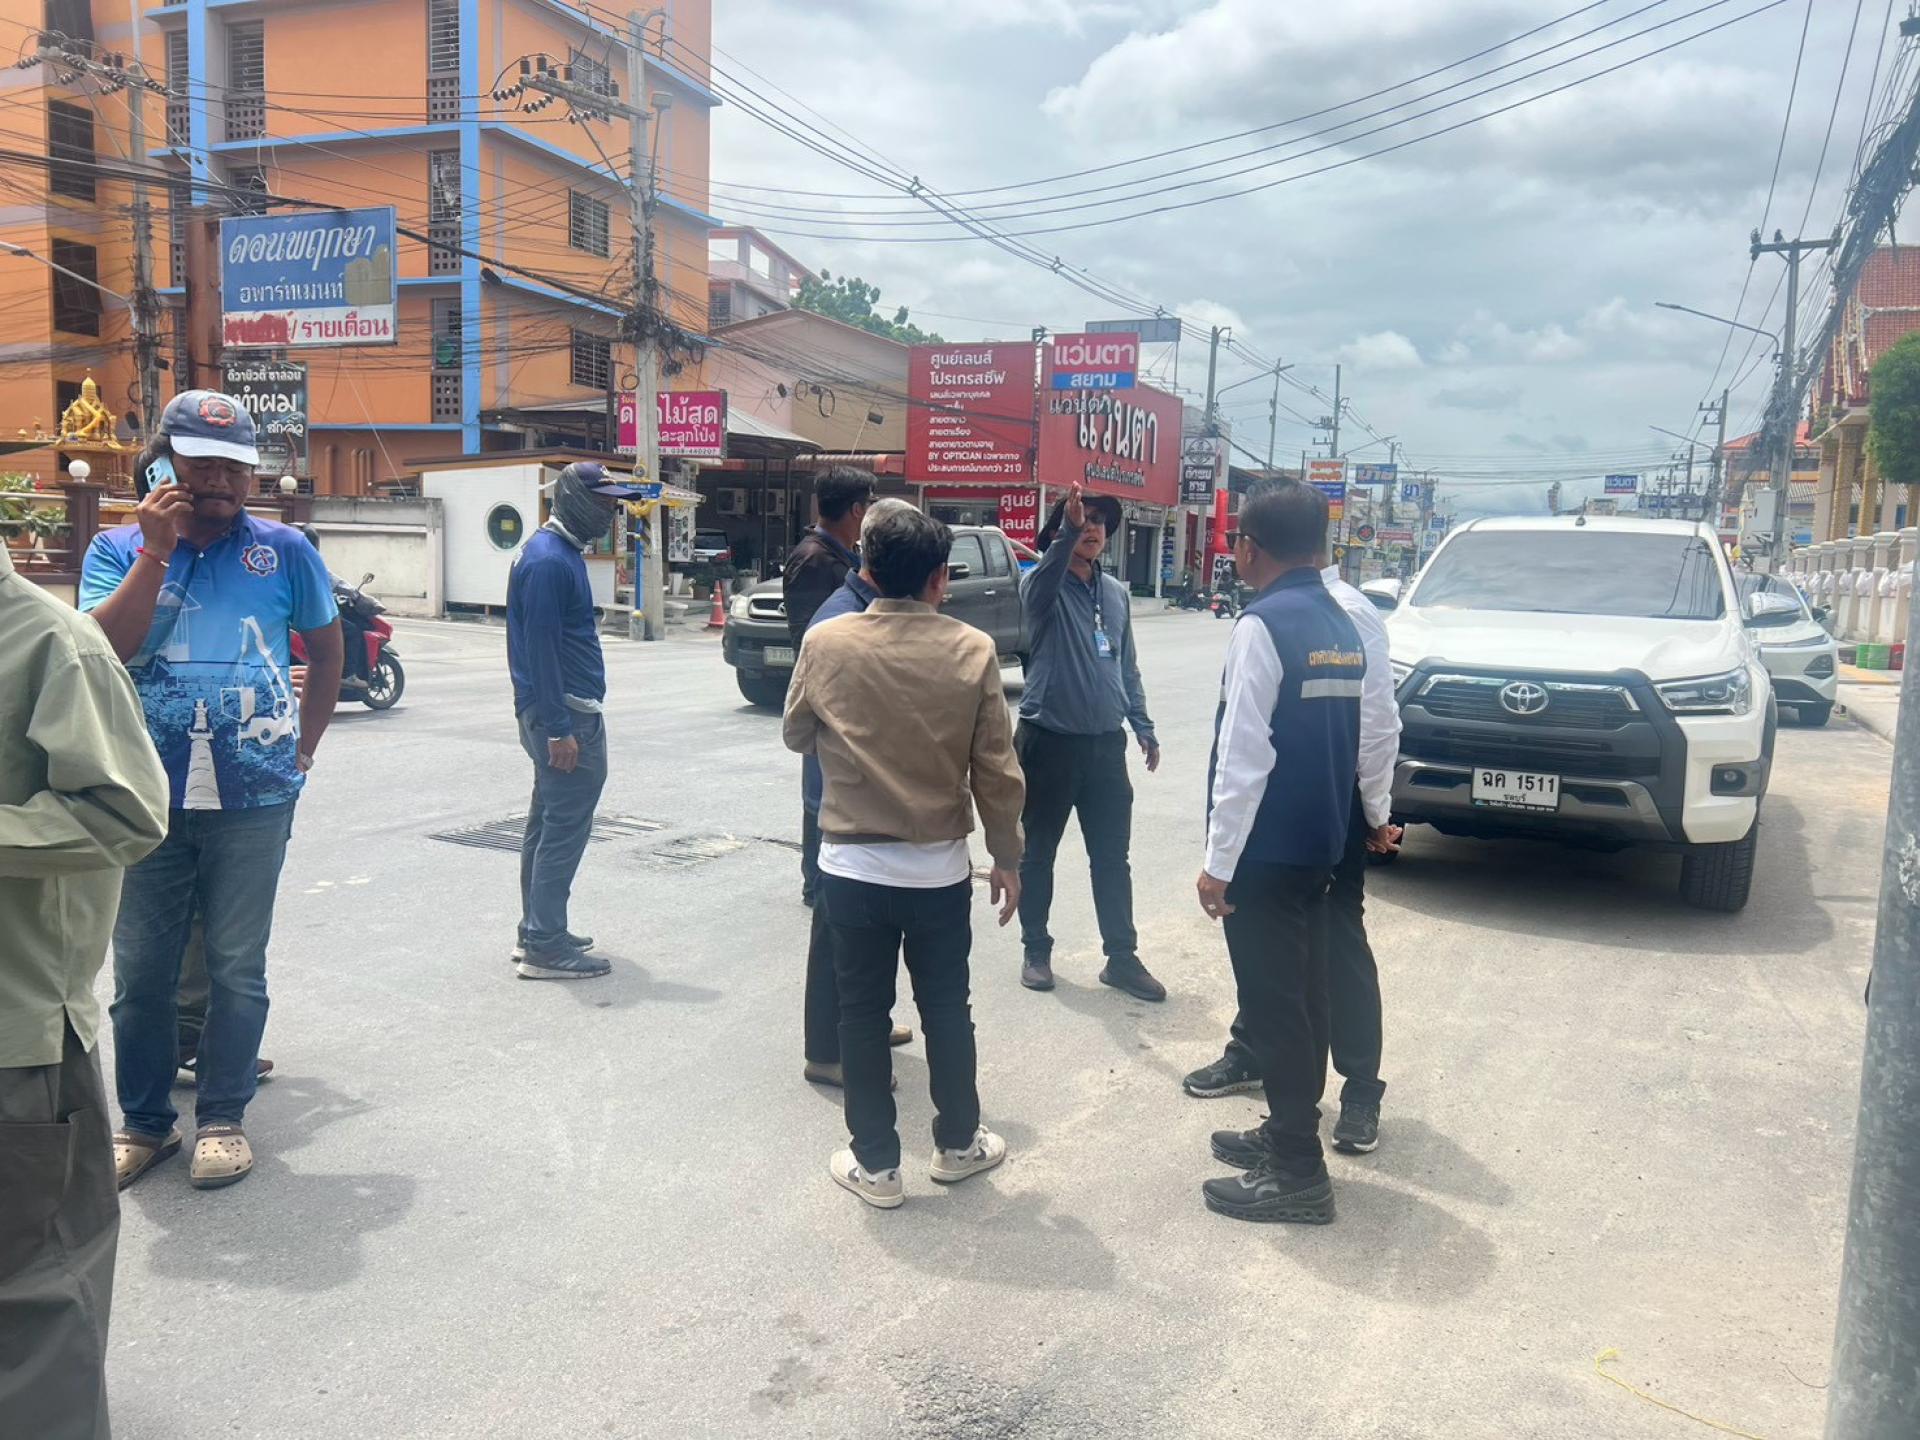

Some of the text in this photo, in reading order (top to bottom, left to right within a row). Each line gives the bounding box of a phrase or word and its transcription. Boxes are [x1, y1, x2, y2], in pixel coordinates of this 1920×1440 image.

[229, 225, 376, 271] ดอนพฤกษา
[239, 272, 344, 303] อพาร์ทเมนท์
[301, 311, 390, 338] รายเดือน
[930, 350, 992, 369] ศูนย์เลนส์
[1054, 338, 1135, 365] แว่นตา
[929, 369, 1006, 385] โปรเกรสซีฟ
[1070, 373, 1117, 387] สยาม
[1000, 491, 1036, 512] ศูนย์
[999, 515, 1036, 530] เลนส์
[1481, 772, 1555, 793] ฉค 1511
